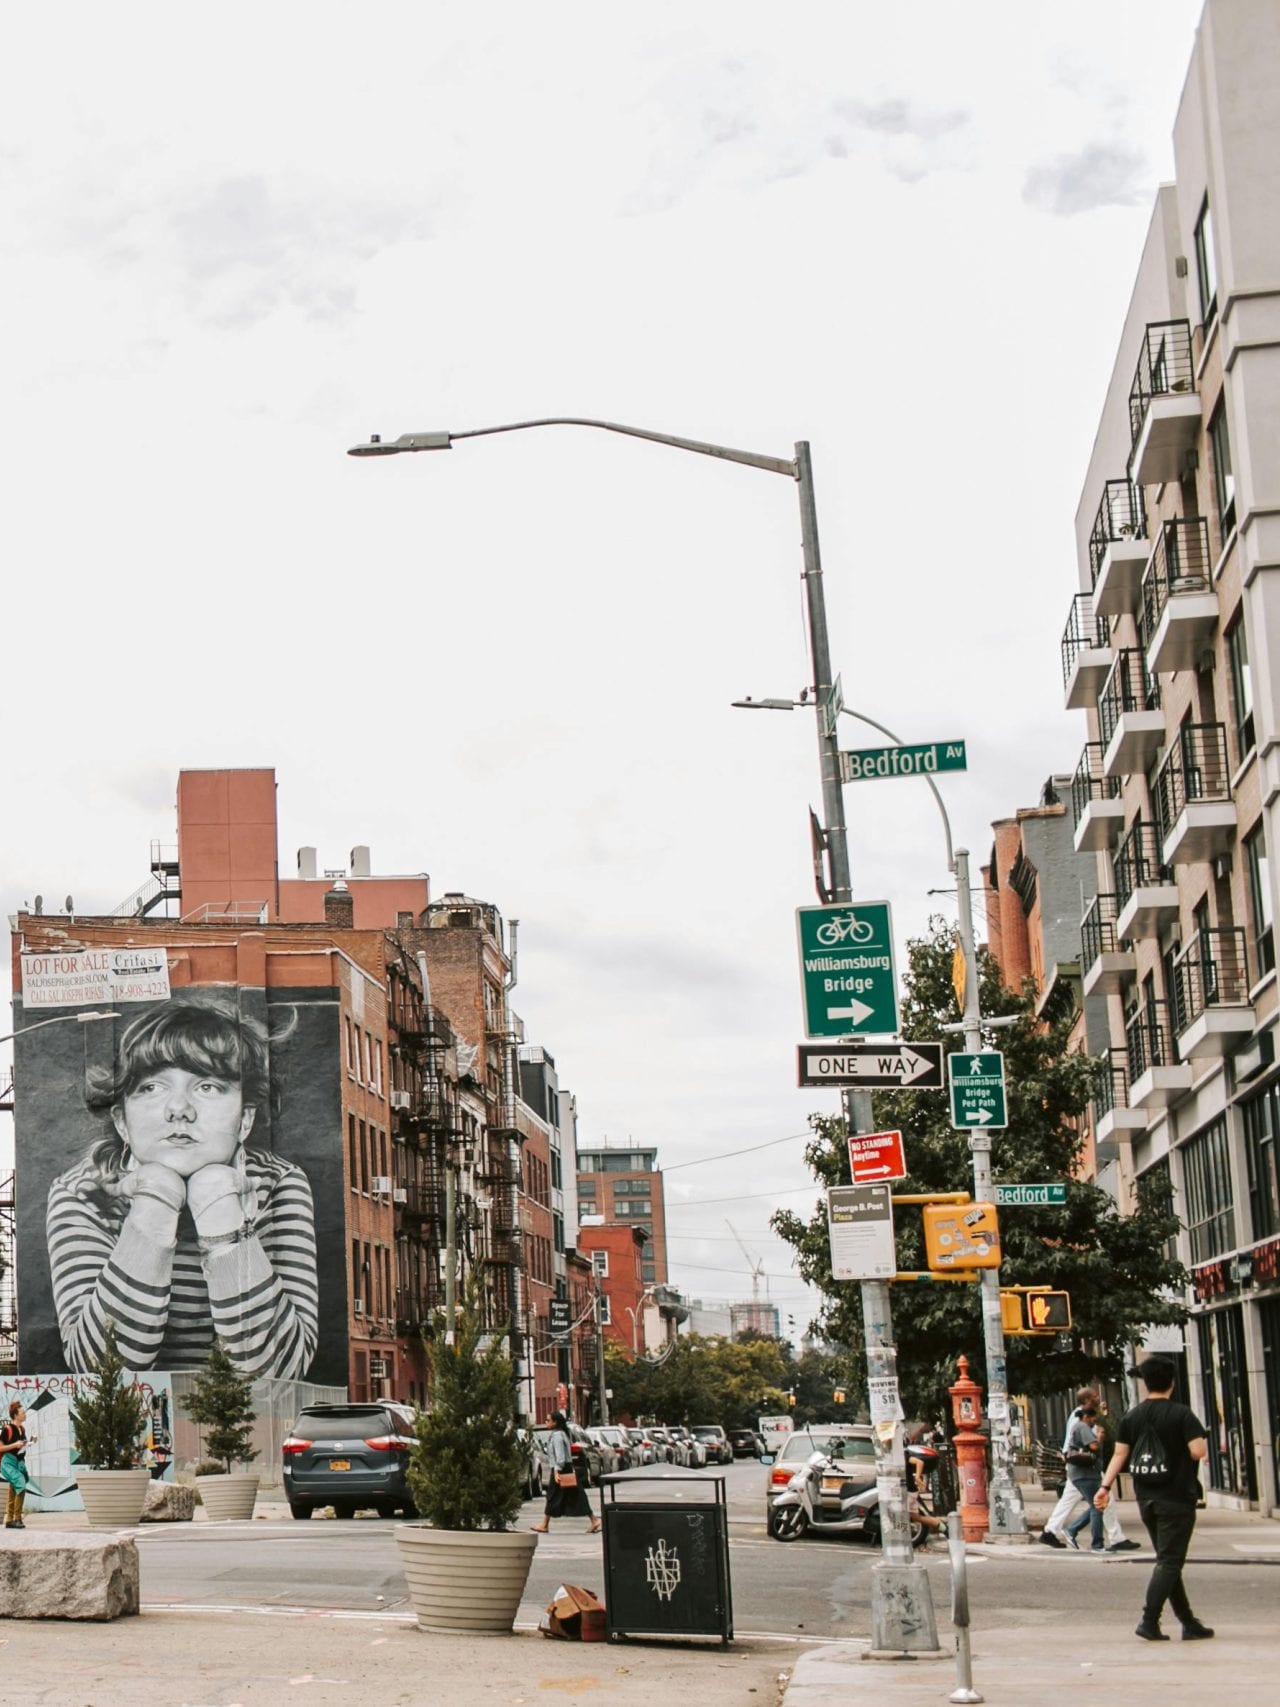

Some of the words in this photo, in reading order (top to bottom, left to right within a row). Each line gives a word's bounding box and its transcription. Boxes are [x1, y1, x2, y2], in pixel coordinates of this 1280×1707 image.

[849, 746, 938, 778] Bedford
[946, 746, 963, 758] Av
[25, 958, 50, 975] LOT
[54, 956, 79, 974] FOR
[115, 952, 158, 968] Crifasi
[805, 955, 891, 972] Williamsburg
[110, 981, 168, 999] 718-908-4223
[824, 976, 874, 993] Bridge
[818, 1057, 859, 1074] ONE
[877, 1057, 919, 1074] WAY
[952, 1077, 1003, 1088] Williamsburg
[965, 1088, 991, 1099] Bridge
[962, 1099, 977, 1108] Ped
[978, 1098, 996, 1107] Path
[851, 1142, 861, 1151] NO
[862, 1136, 894, 1149] STANDING
[853, 1150, 880, 1162] Anytime
[996, 1186, 1048, 1203] Bedford
[1052, 1187, 1064, 1196] Av
[832, 1204, 858, 1213] George
[867, 1202, 884, 1211] Post
[761, 1423, 790, 1432] FedEx
[1129, 1463, 1168, 1474] TIDAL
